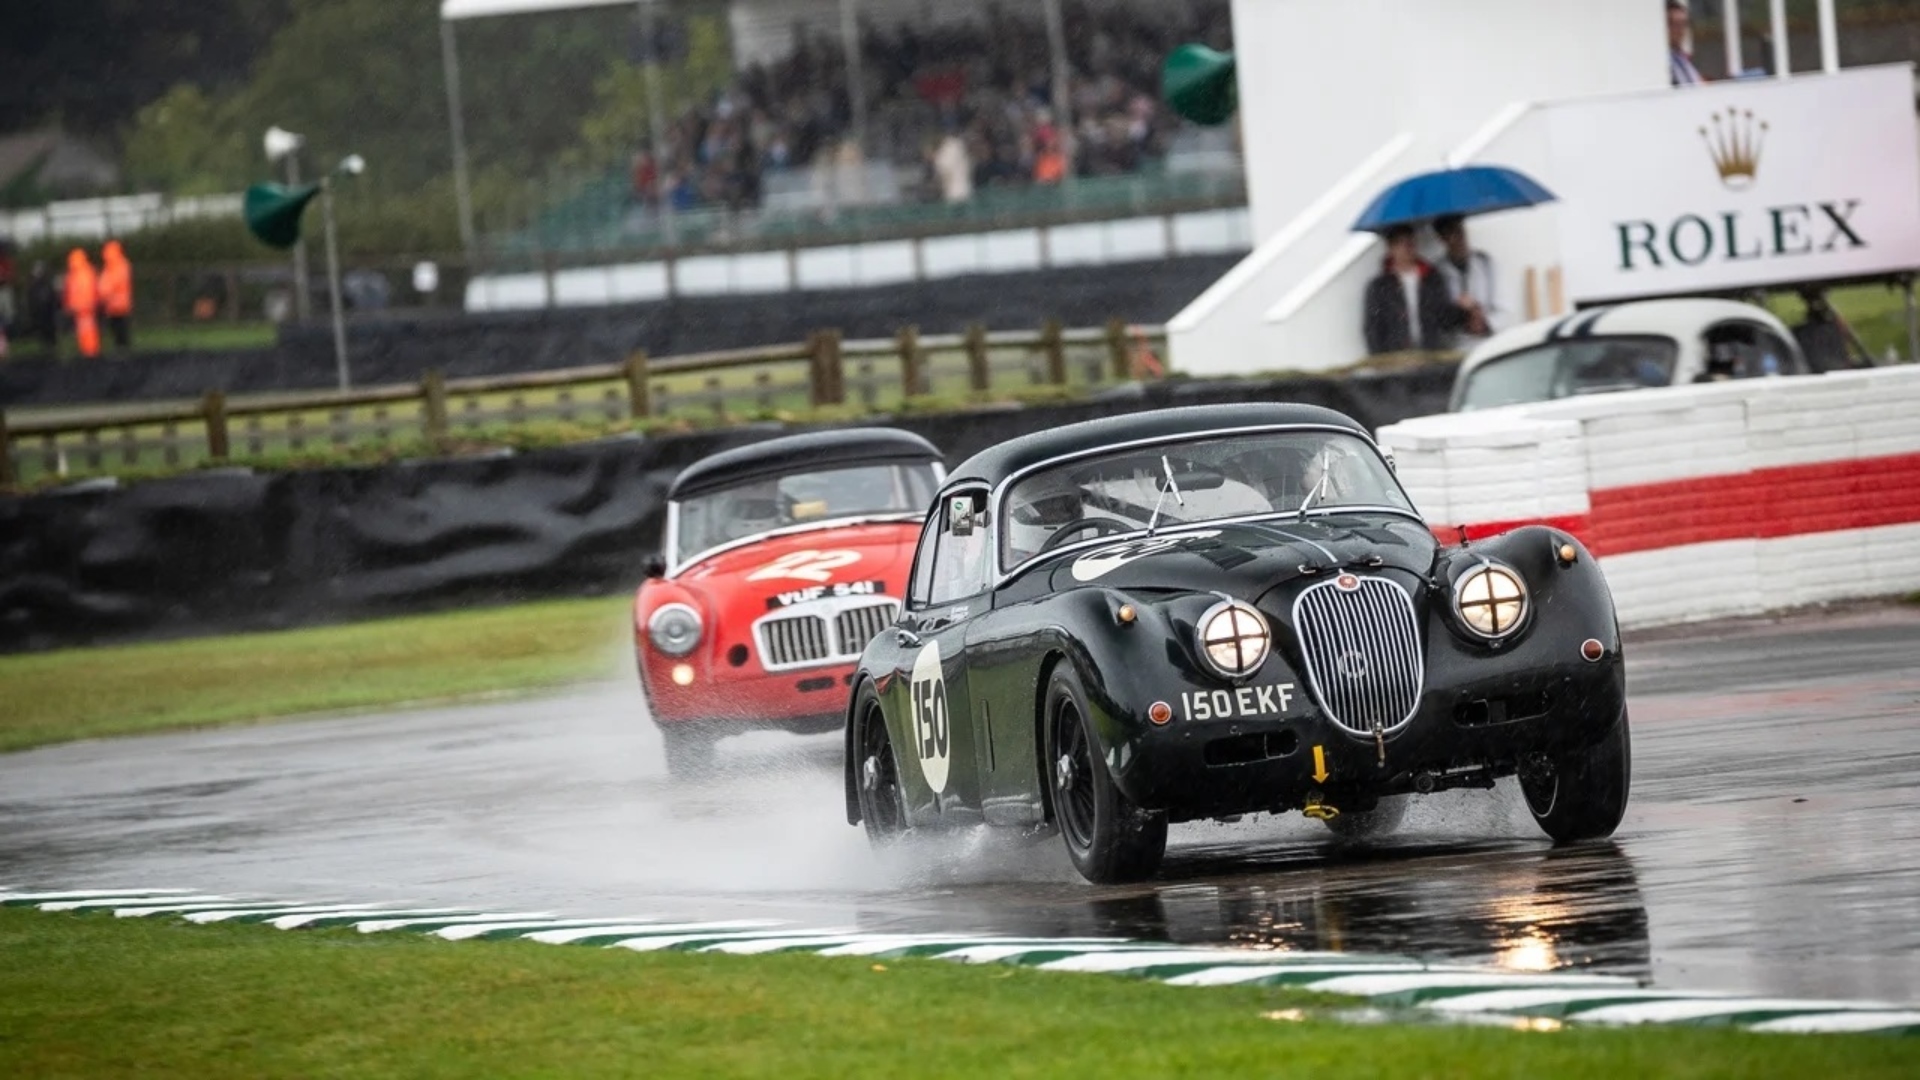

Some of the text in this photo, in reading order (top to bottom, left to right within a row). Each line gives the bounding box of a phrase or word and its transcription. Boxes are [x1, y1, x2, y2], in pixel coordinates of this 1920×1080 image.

[1613, 198, 1868, 271] ROLEX
[745, 550, 862, 582] 22
[777, 580, 875, 606] VUF 541
[913, 678, 948, 759] 150
[1182, 683, 1294, 720] 150 EKF
